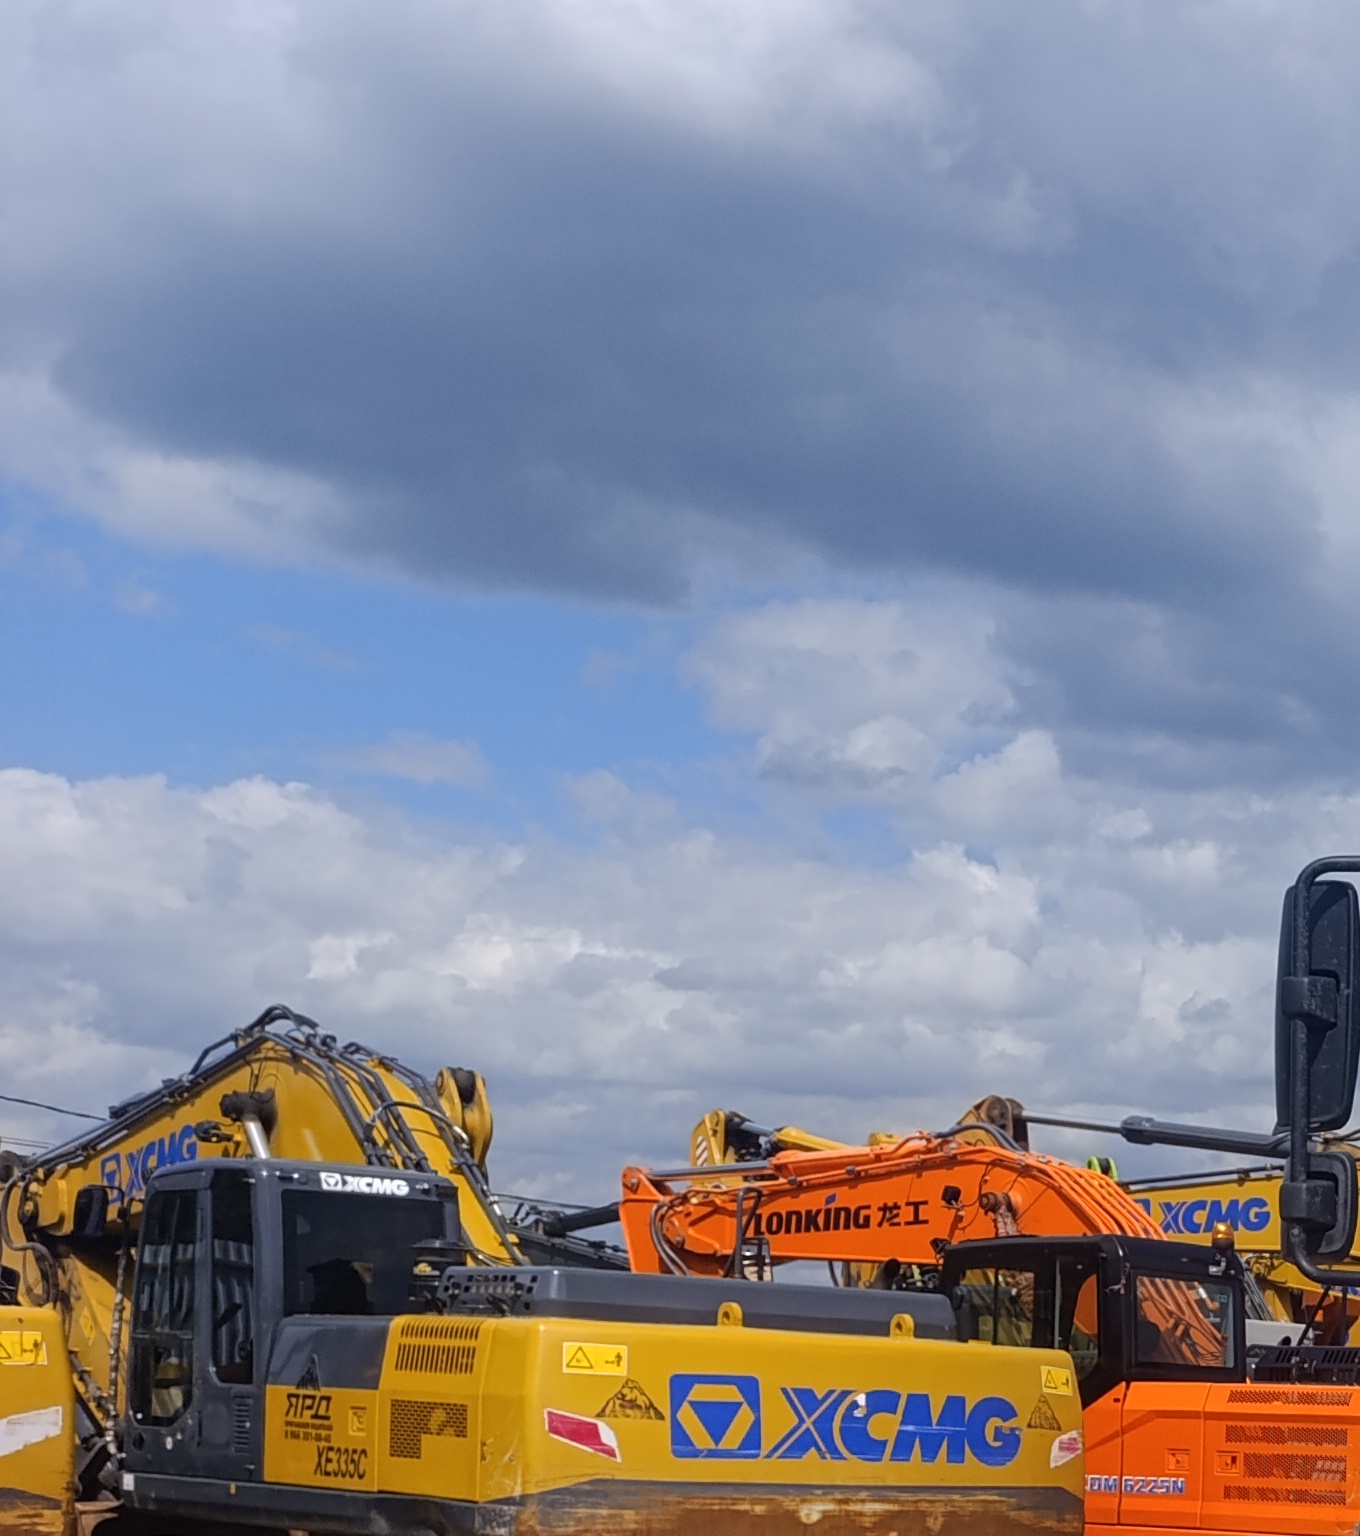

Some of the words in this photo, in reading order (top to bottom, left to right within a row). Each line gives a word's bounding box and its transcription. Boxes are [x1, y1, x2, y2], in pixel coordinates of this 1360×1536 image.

[341, 1176, 410, 1197] XCMG
[876, 1199, 930, 1228] 龙工
[1160, 1197, 1271, 1234] XCMG
[284, 1392, 332, 1421] ЯРД
[763, 1386, 1023, 1467] XCMG
[313, 1445, 368, 1480] XE335C
[1122, 1476, 1186, 1495] 6225N
